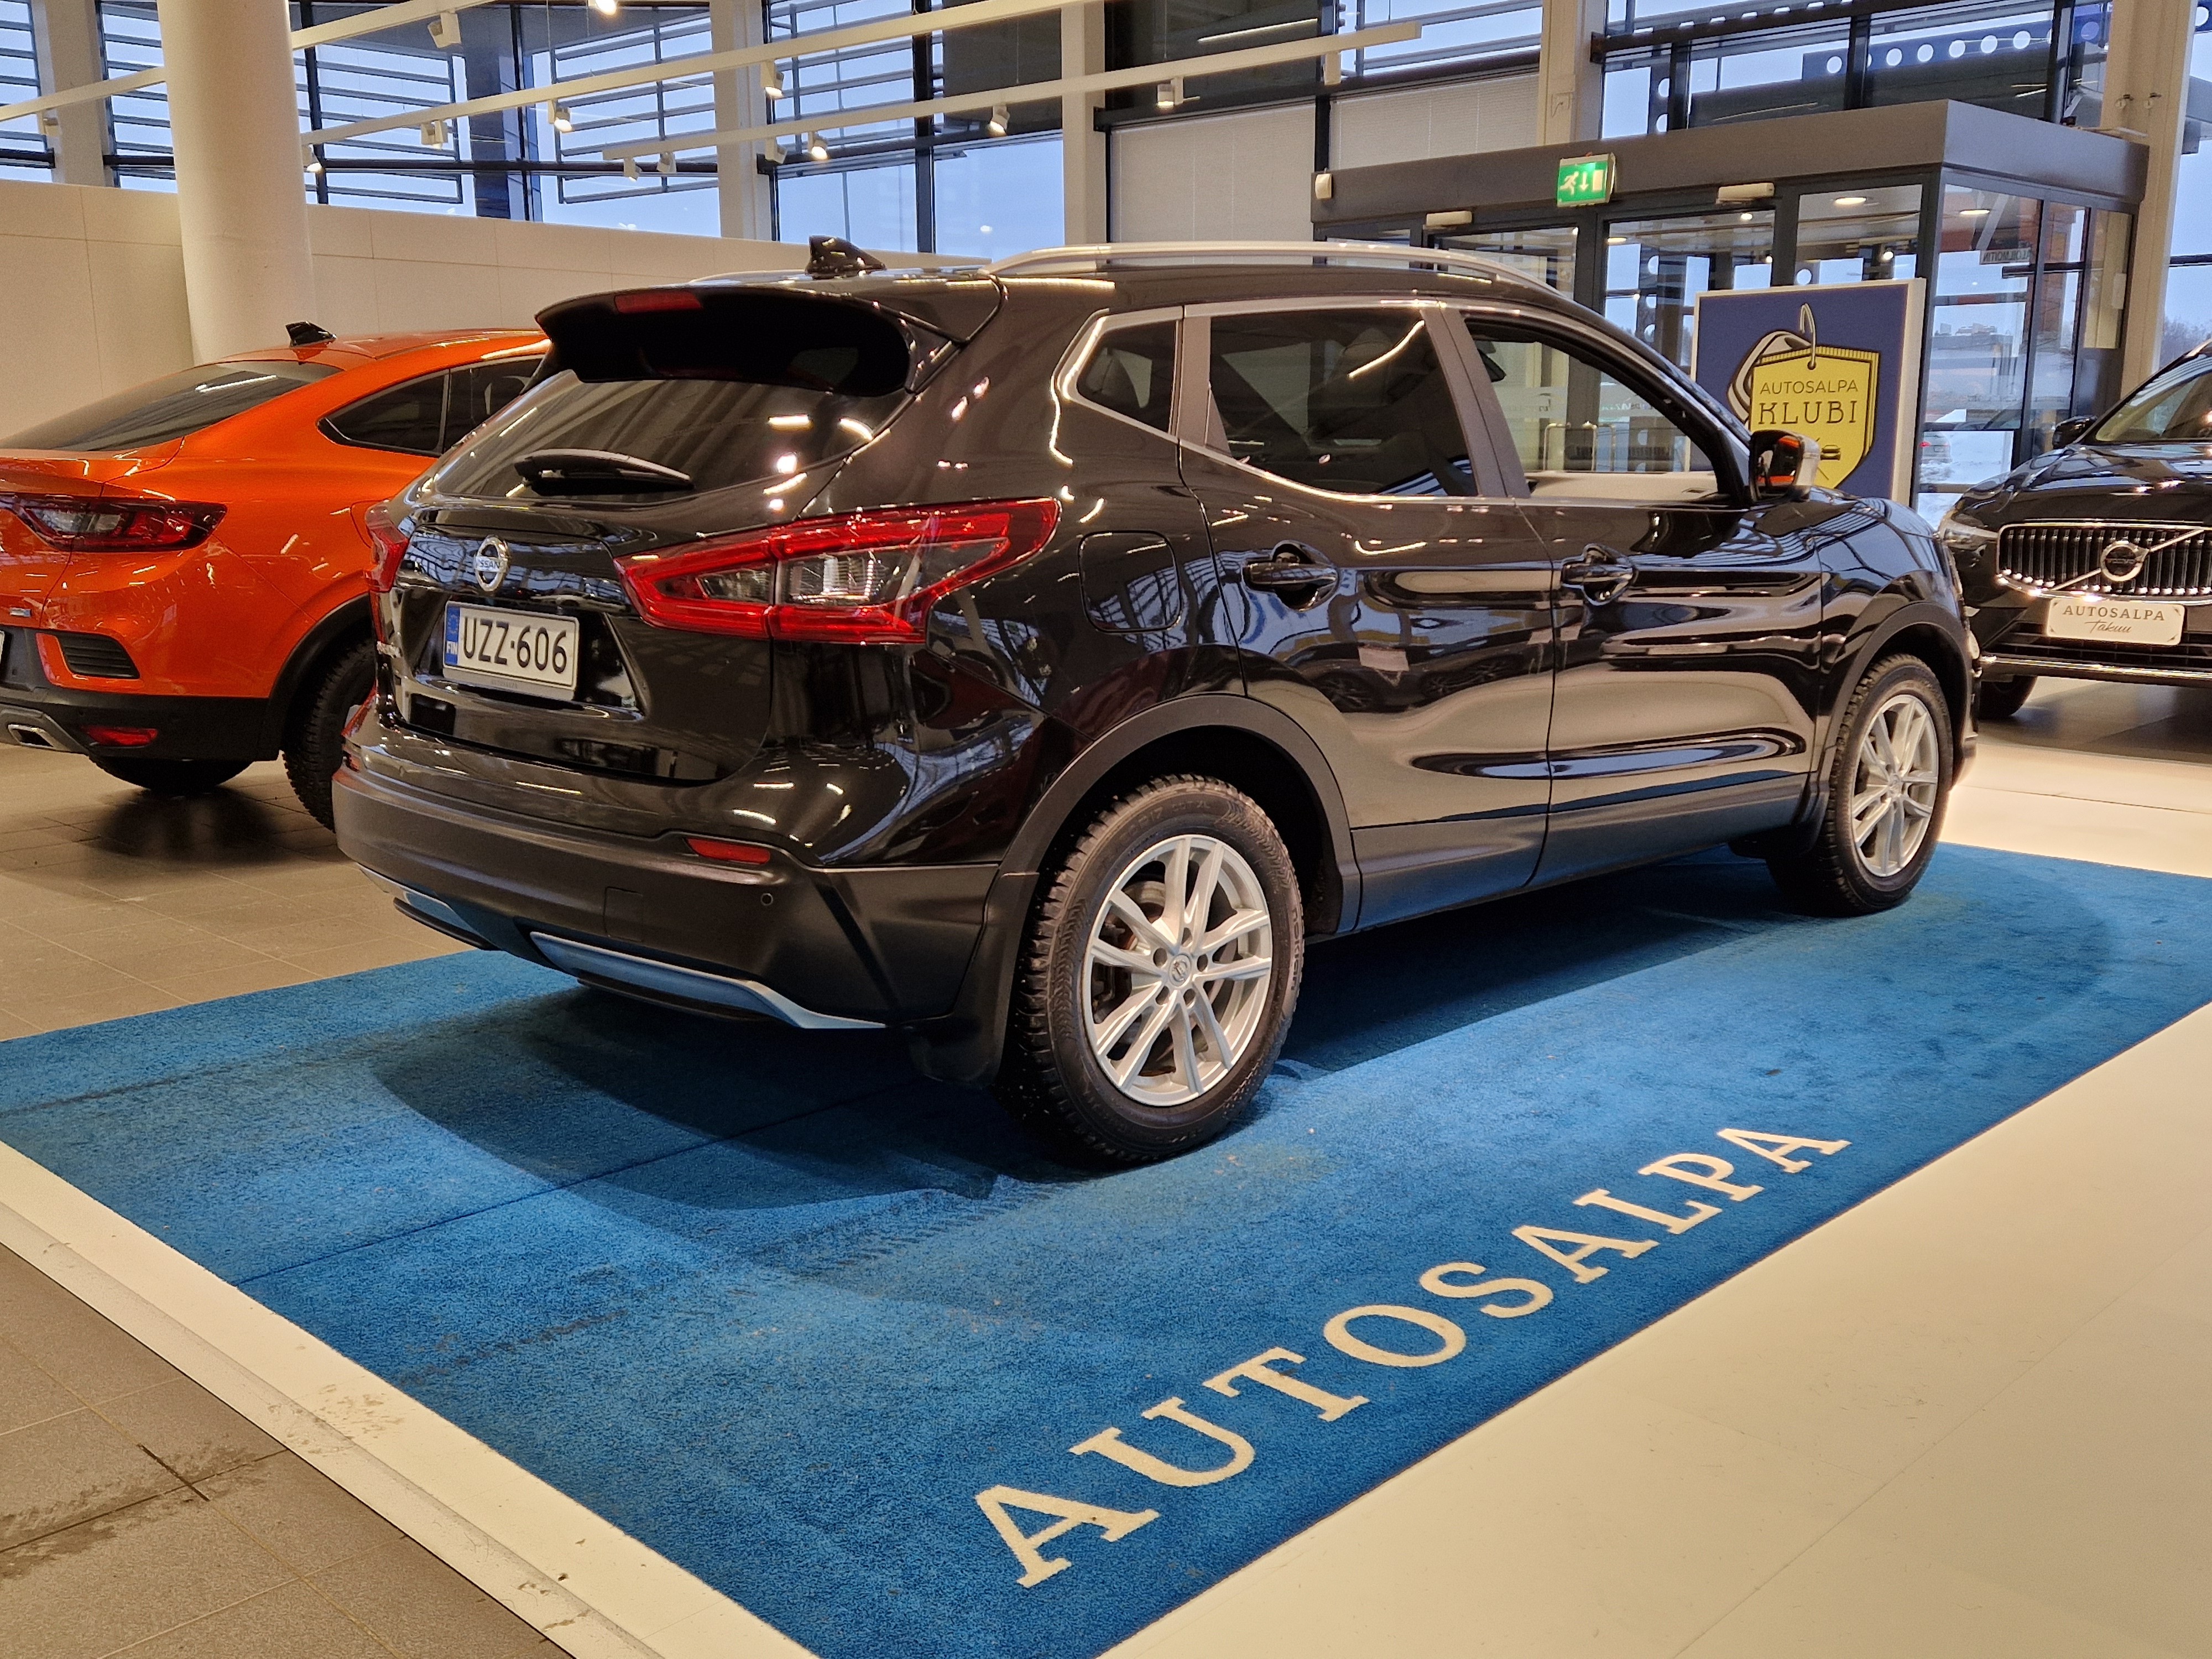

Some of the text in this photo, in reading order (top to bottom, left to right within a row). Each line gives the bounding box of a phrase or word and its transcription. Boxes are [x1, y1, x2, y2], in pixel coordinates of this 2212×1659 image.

[1760, 379, 1858, 394] AUTOSALPA
[1758, 400, 1858, 424] KLUBI
[2063, 605, 2171, 621] AUTOSALPA
[2084, 619, 2132, 634] Takuu
[446, 641, 457, 654] FIN
[463, 616, 567, 674] UZZ-606
[973, 1127, 1852, 1588] AUTOSALPA
